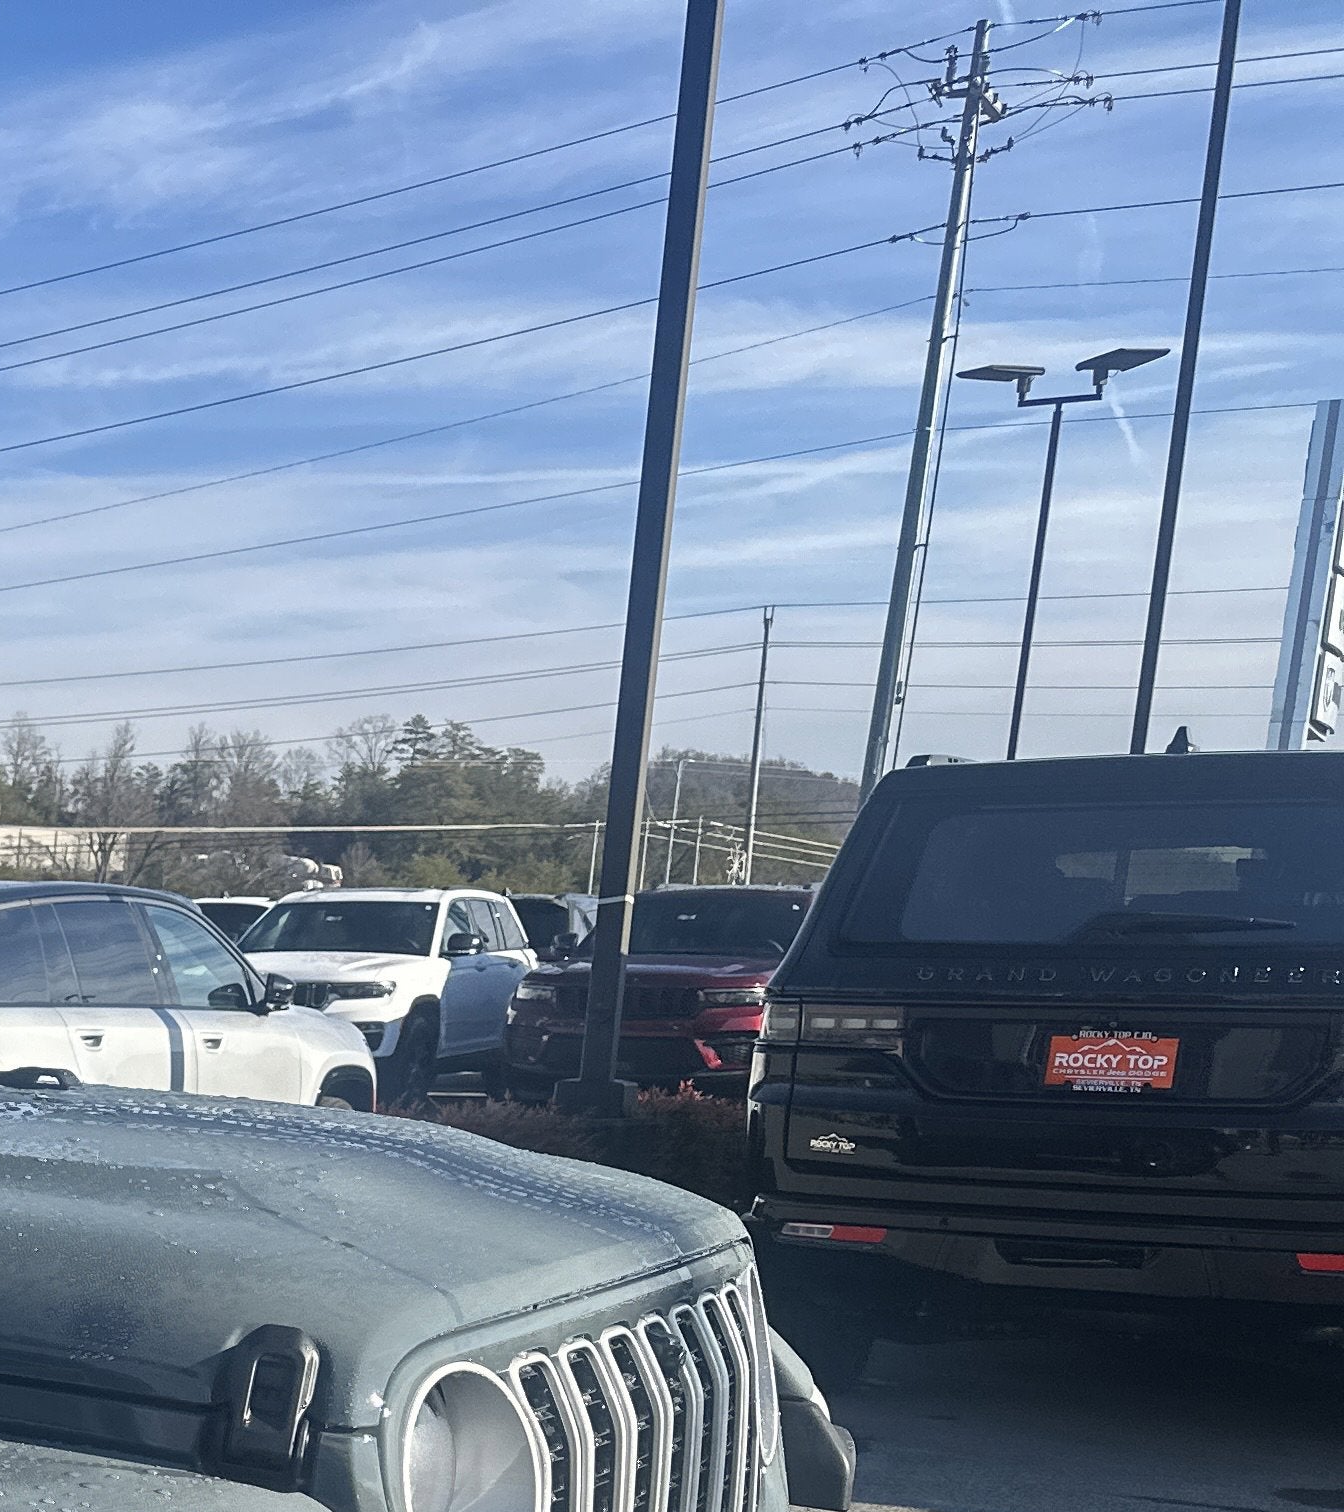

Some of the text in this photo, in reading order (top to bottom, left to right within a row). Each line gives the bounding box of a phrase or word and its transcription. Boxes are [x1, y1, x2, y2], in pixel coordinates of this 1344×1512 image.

[916, 966, 1344, 984] GRAND WAGONEER
[1079, 1030, 1110, 1039] ROCKY
[1113, 1030, 1132, 1040] TOP
[1054, 1053, 1169, 1069] ROCKY TOP
[1052, 1068, 1105, 1076] CHRYSLER
